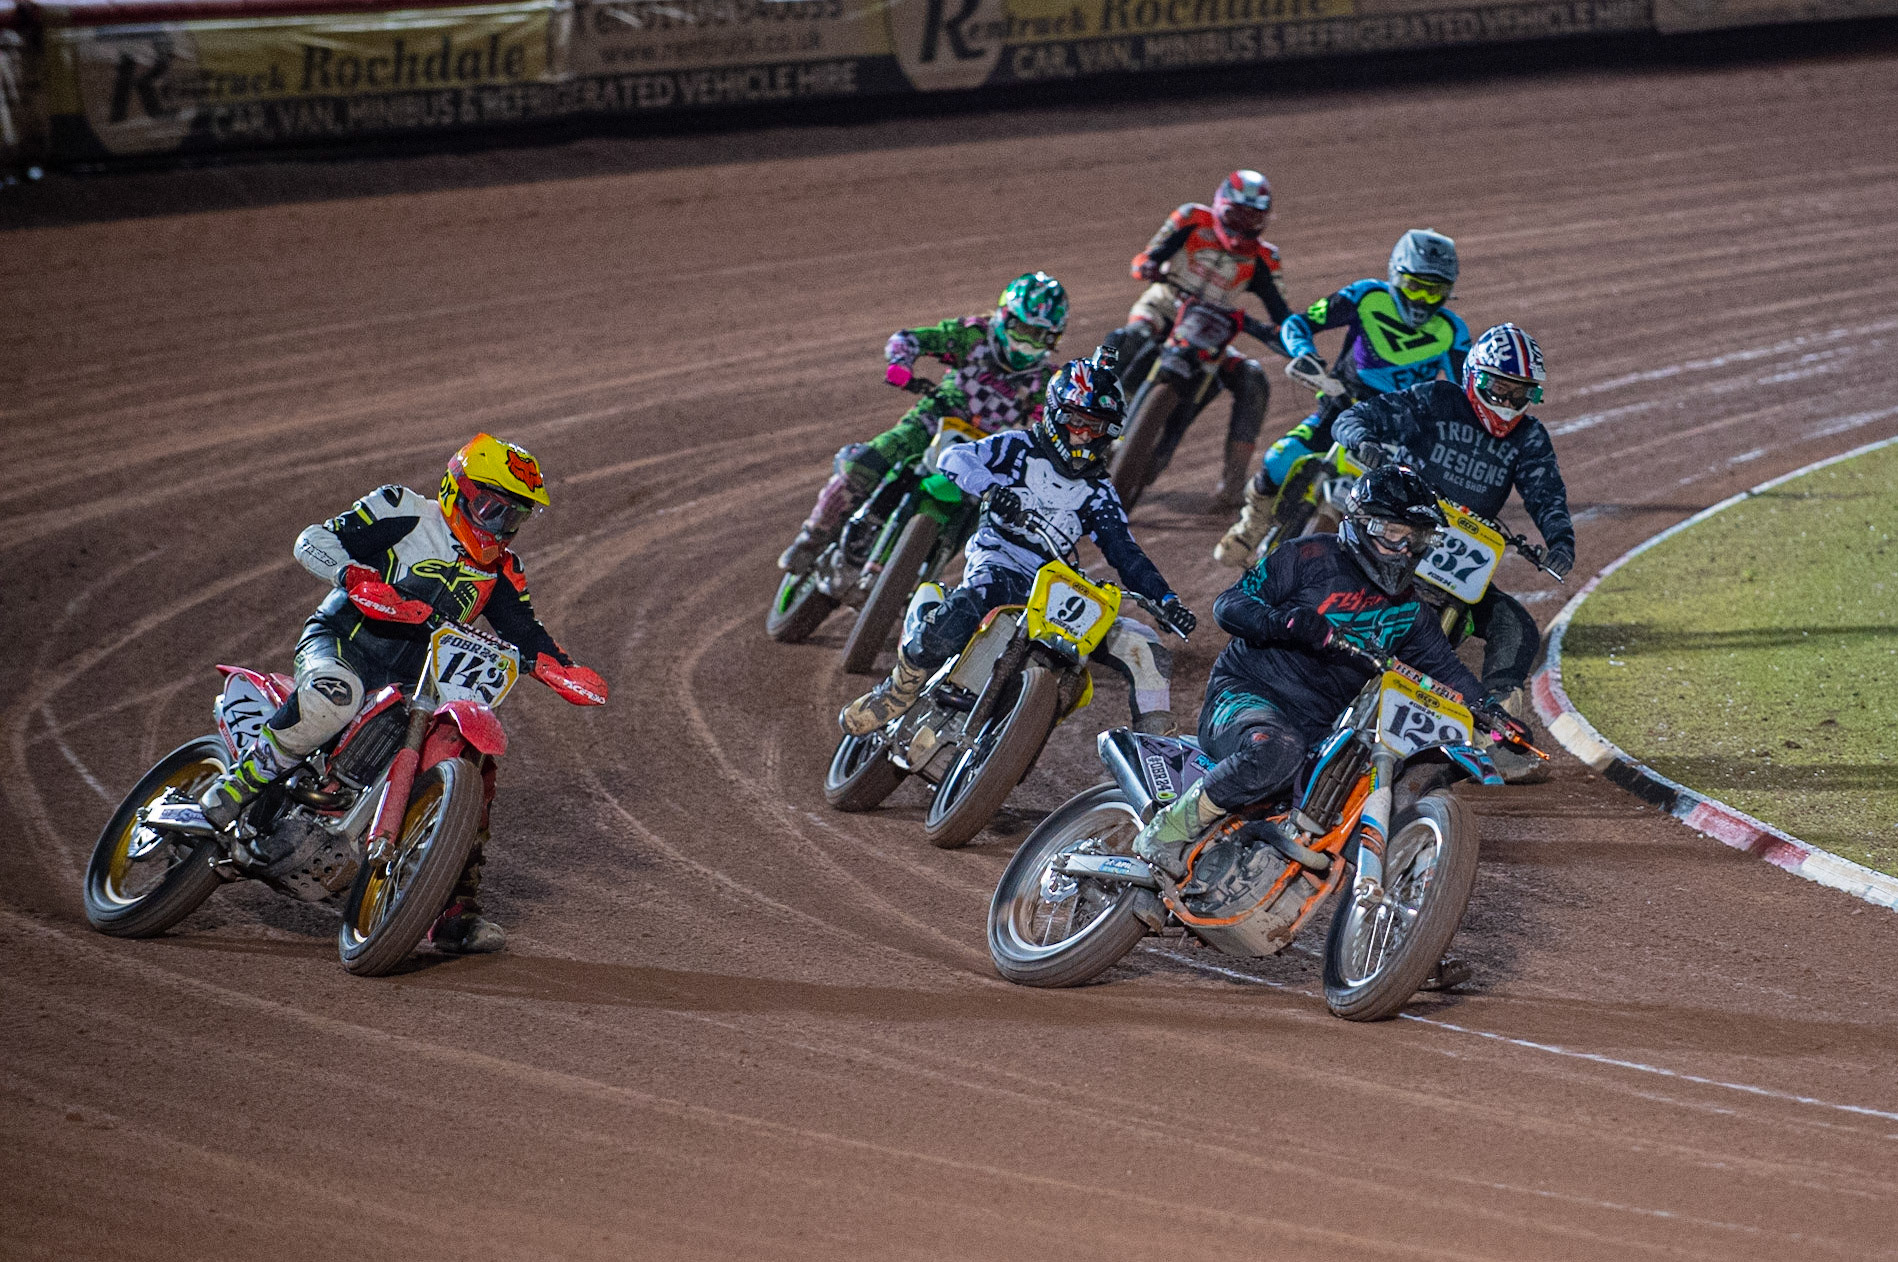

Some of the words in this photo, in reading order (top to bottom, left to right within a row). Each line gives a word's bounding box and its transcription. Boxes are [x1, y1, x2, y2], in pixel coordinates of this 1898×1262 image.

[300, 32, 526, 93] Rochdale
[1429, 442, 1508, 487] DESIGNS
[1435, 420, 1485, 448] TROY
[1487, 438, 1520, 467] LEE
[1442, 471, 1465, 487] RACE
[1464, 479, 1488, 494] SHOP
[1057, 595, 1086, 623] 9
[438, 651, 505, 705] 142
[1395, 664, 1456, 701] RENHAL
